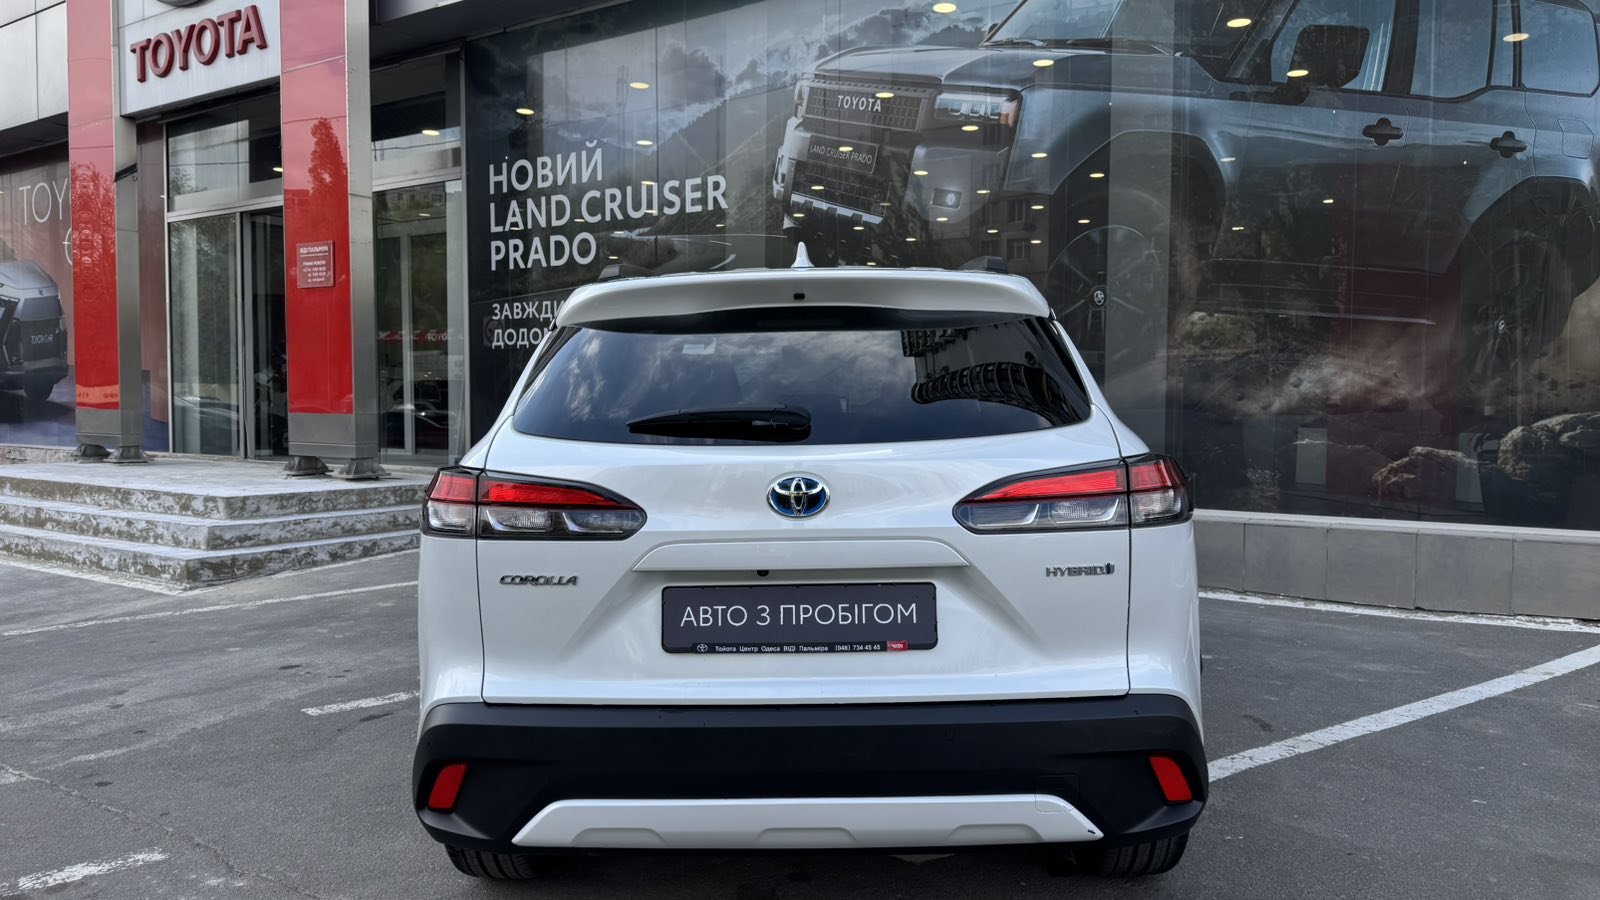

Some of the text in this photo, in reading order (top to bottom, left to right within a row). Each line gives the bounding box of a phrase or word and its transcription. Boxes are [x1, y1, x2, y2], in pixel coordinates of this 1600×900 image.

[130, 5, 268, 83] TOYOTA
[837, 95, 881, 112] TOYOTA
[810, 144, 825, 155] LAND
[851, 151, 873, 165] PRADO
[489, 139, 603, 195] НОВИЙ
[19, 178, 71, 225] TOY
[490, 175, 728, 233] LAND CRUISER
[491, 232, 597, 271] PRADO
[426, 332, 448, 341] TOYO
[499, 575, 579, 586] COROLLA
[1045, 565, 1105, 577] HYBRID
[680, 603, 917, 627] АВТО З ПРОБІГОМ
[739, 645, 759, 653] Центр
[761, 645, 780, 653] Одеса
[835, 644, 851, 652] (048)
